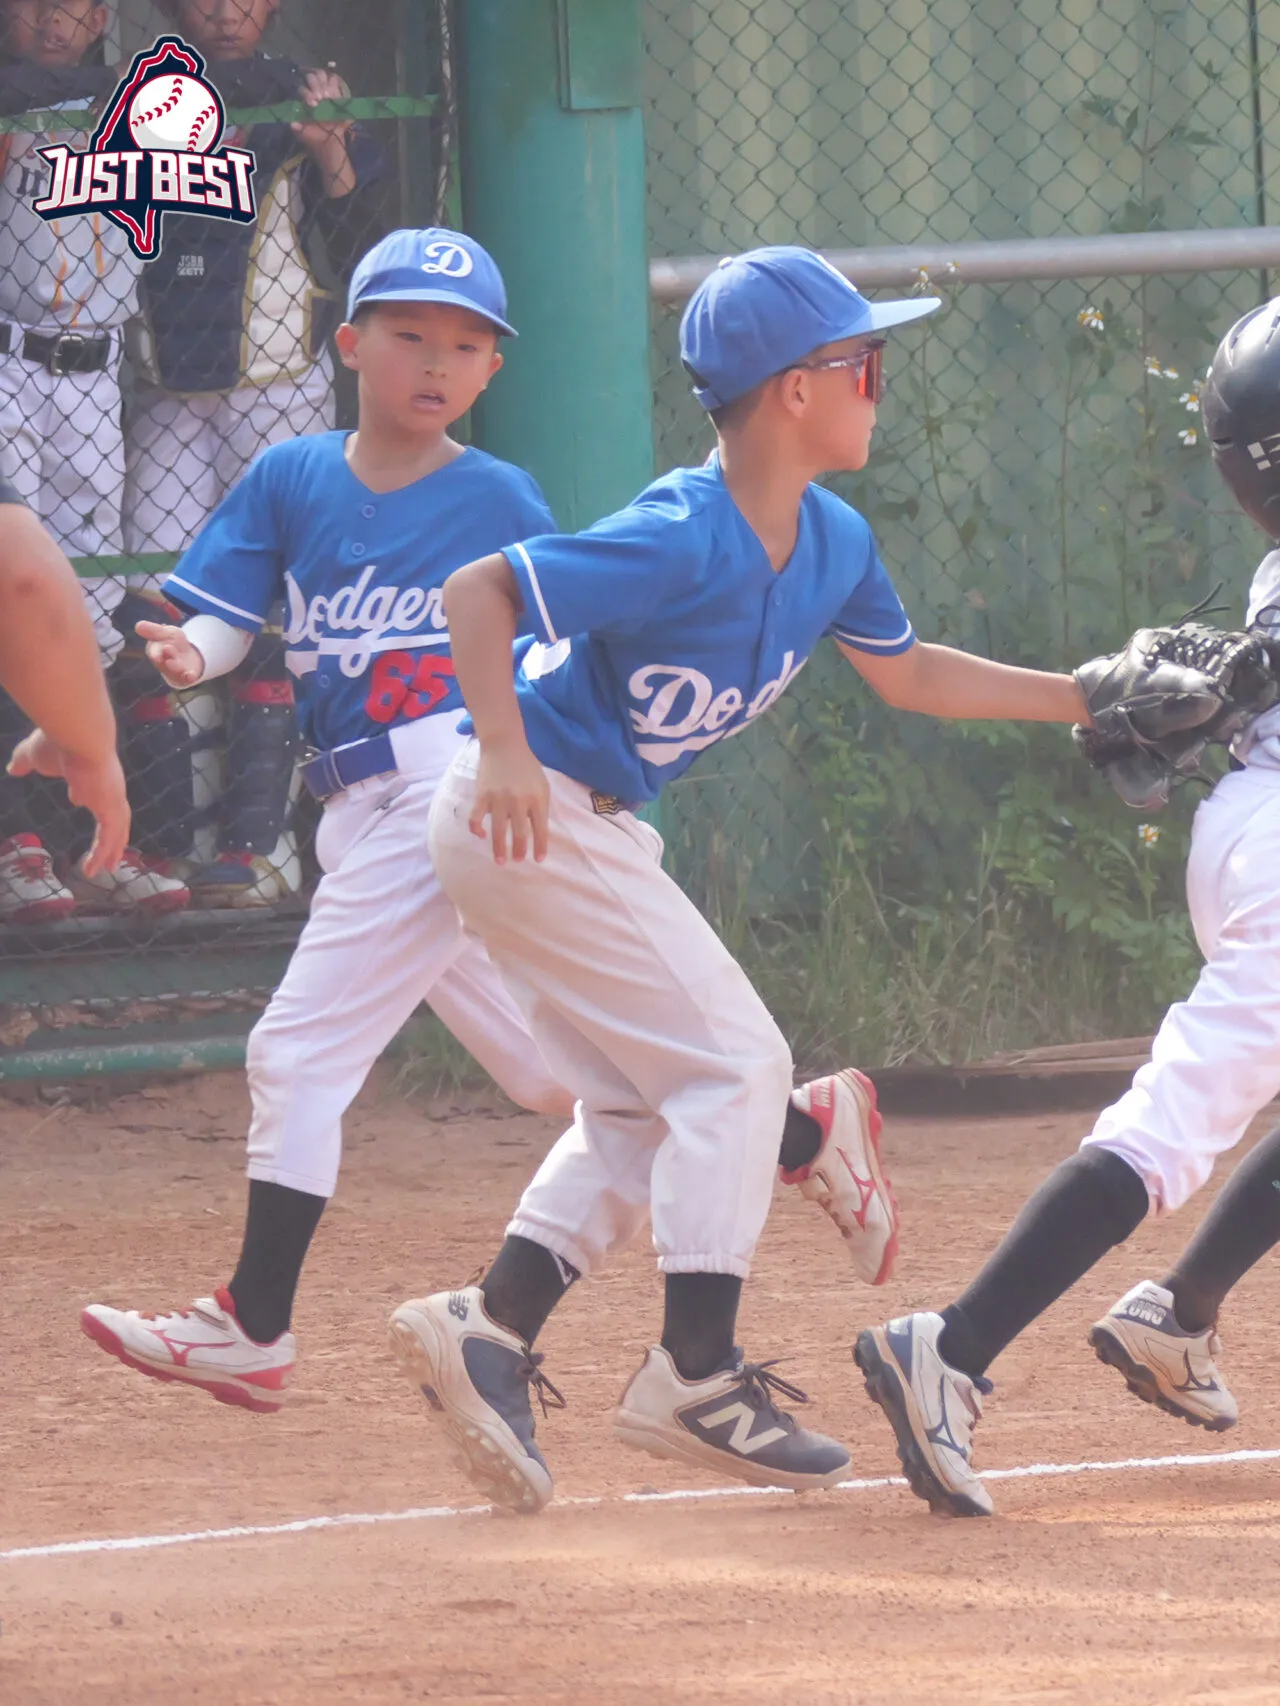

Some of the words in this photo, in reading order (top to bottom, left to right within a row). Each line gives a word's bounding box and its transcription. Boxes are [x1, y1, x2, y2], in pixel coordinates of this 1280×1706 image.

[421, 241, 473, 277] D
[283, 565, 450, 678] odger
[365, 650, 456, 723] 65
[628, 650, 808, 738] Dod
[696, 1401, 789, 1456] N
